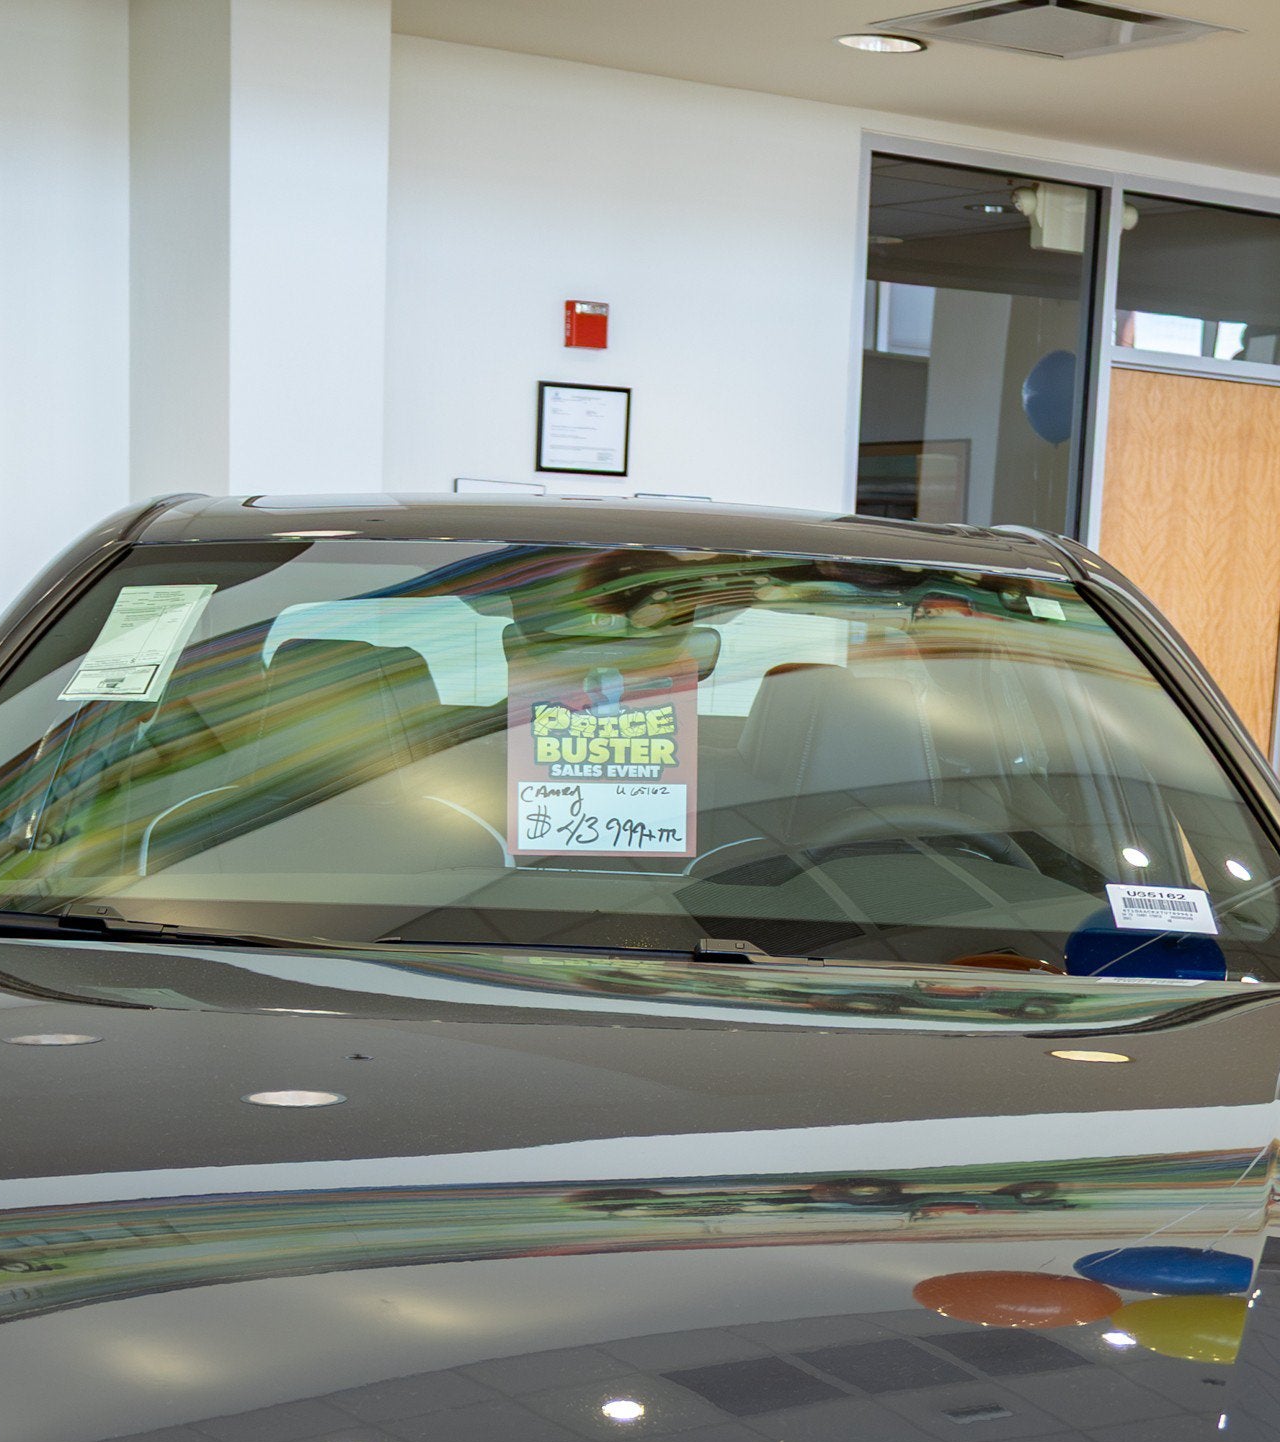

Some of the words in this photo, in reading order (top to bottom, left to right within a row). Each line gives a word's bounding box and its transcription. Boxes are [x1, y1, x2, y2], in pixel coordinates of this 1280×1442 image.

[533, 704, 675, 738] PRICE
[536, 737, 677, 764] BUSTER
[551, 764, 603, 777] SALES
[606, 764, 661, 778] EVENT
